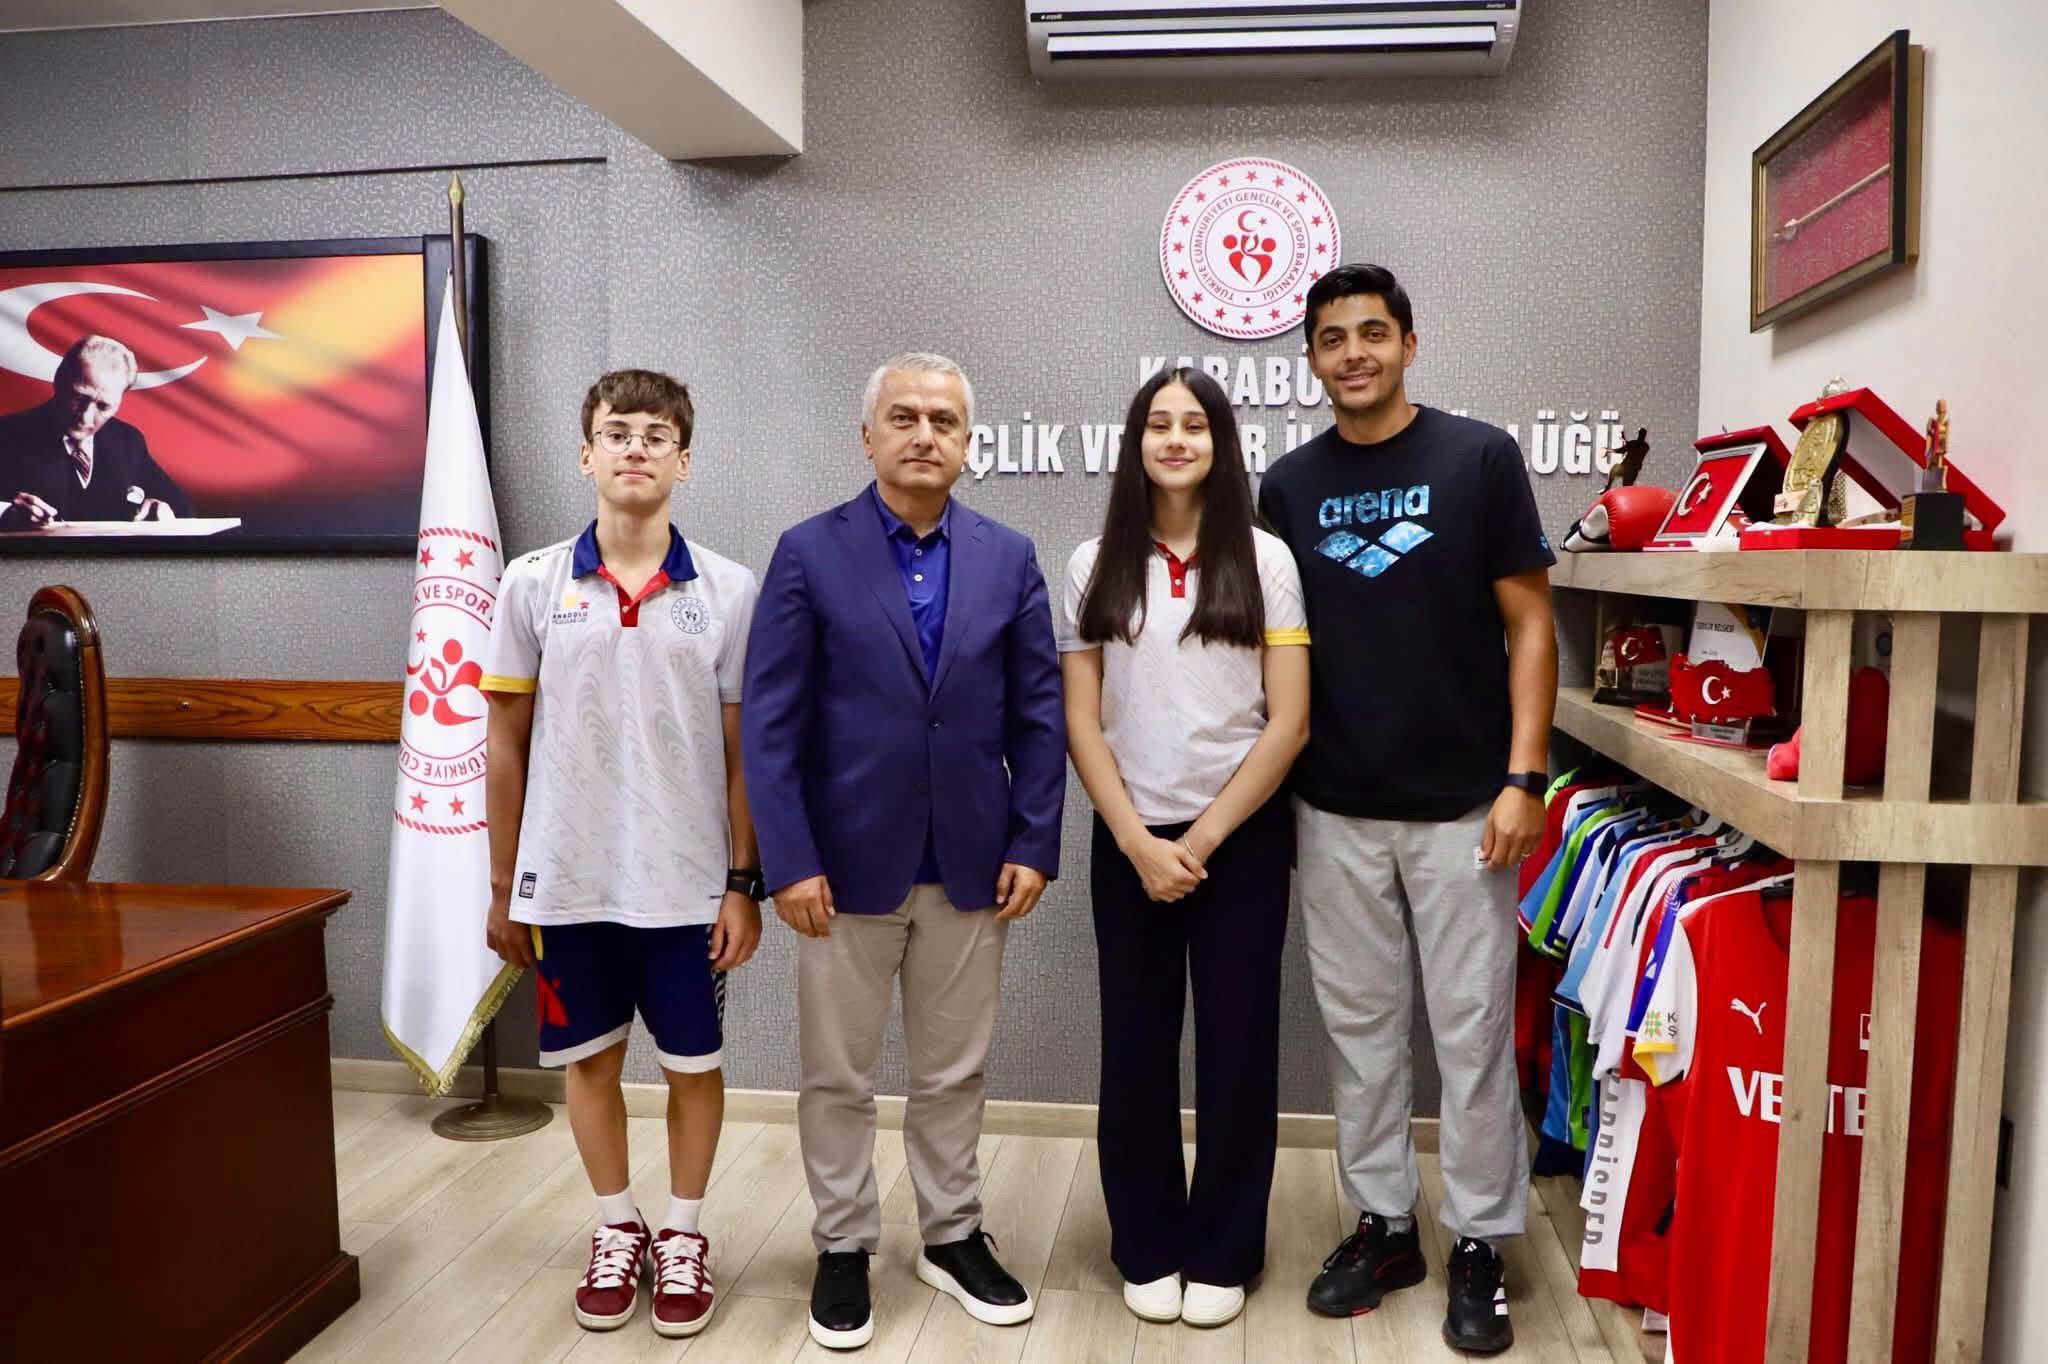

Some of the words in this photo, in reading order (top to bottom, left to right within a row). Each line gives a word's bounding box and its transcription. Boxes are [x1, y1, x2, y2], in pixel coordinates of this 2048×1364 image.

[1282, 205, 1295, 219] VE
[1290, 219, 1306, 249] SPOR
[1318, 484, 1430, 529] arena
[422, 584, 441, 600] VE
[444, 584, 491, 615] SPOR
